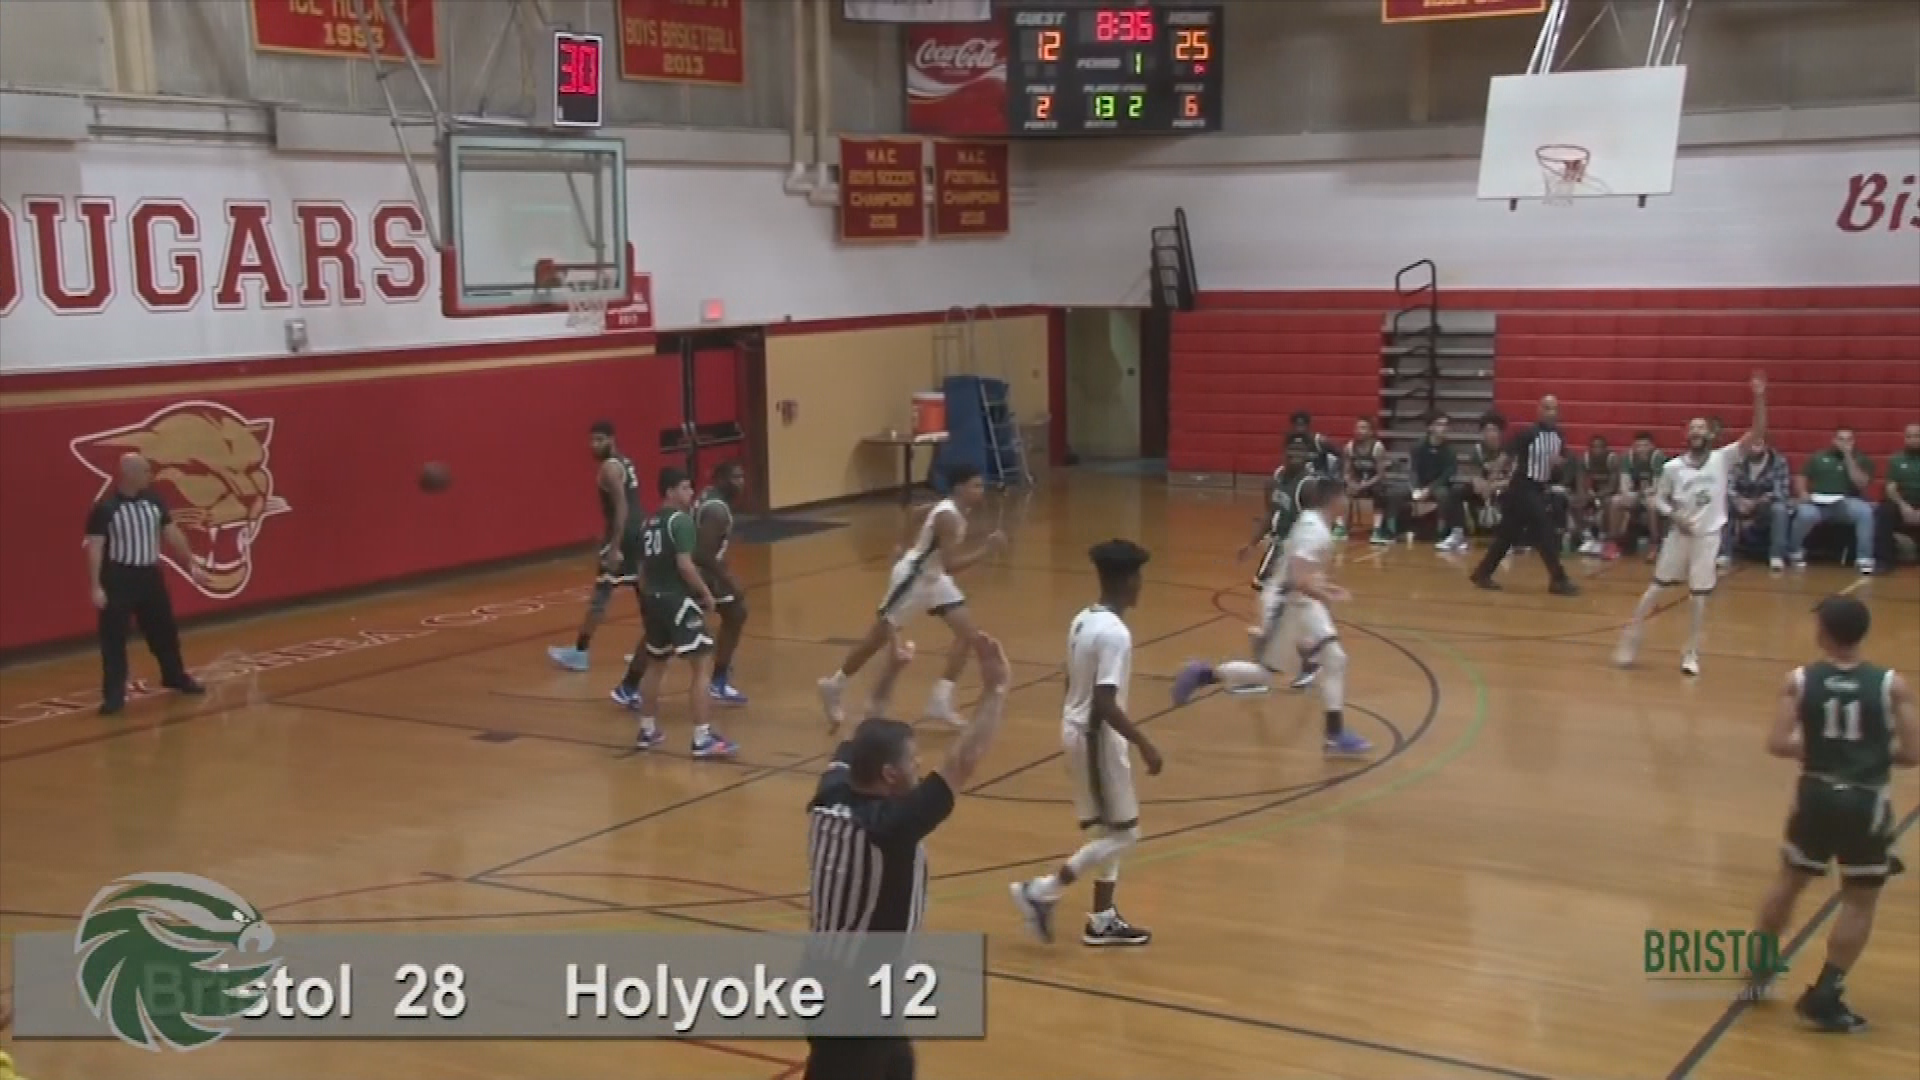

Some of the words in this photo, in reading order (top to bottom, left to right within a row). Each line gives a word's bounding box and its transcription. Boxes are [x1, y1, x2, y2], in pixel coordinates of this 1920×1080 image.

[1015, 12, 1066, 25] GUEST
[1095, 10, 1154, 41] 8:36
[625, 17, 658, 47] BOYS
[660, 20, 737, 55] BASKETBALL
[1037, 30, 1062, 61] 12
[1174, 30, 1210, 61] 25
[559, 42, 597, 95] 30
[1036, 95, 1051, 119] 2
[1095, 95, 1115, 118] 13
[1128, 95, 1143, 118] 2
[1184, 95, 1199, 117] 6
[0, 195, 429, 315] UGARS
[643, 529, 663, 557] 20
[1823, 697, 1862, 740] 11
